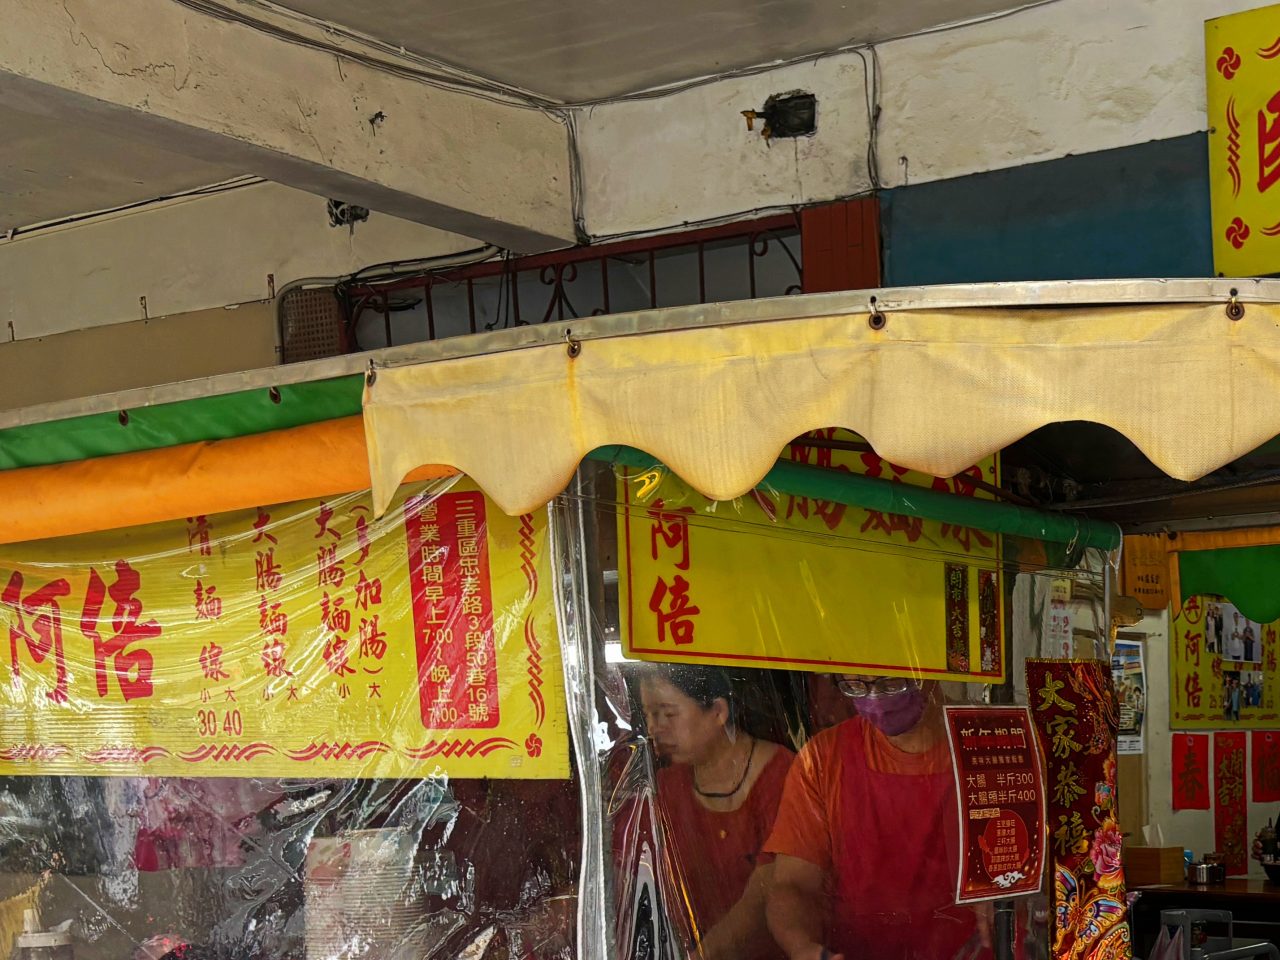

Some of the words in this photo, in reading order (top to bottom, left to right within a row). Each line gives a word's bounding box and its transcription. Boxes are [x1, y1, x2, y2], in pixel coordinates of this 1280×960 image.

[252, 506, 294, 678] 大腸麵線
[315, 500, 356, 678] 大腸麵線
[646, 498, 700, 646] 阿倍
[0, 559, 162, 704] 阿倍
[224, 686, 236, 702] 大
[287, 684, 299, 701] 大
[338, 683, 350, 699] 小
[368, 682, 382, 699] 大
[1184, 629, 1203, 708] 阿倍
[198, 710, 217, 737] 30
[222, 709, 243, 736] 40
[996, 772, 1034, 788] 半斤300
